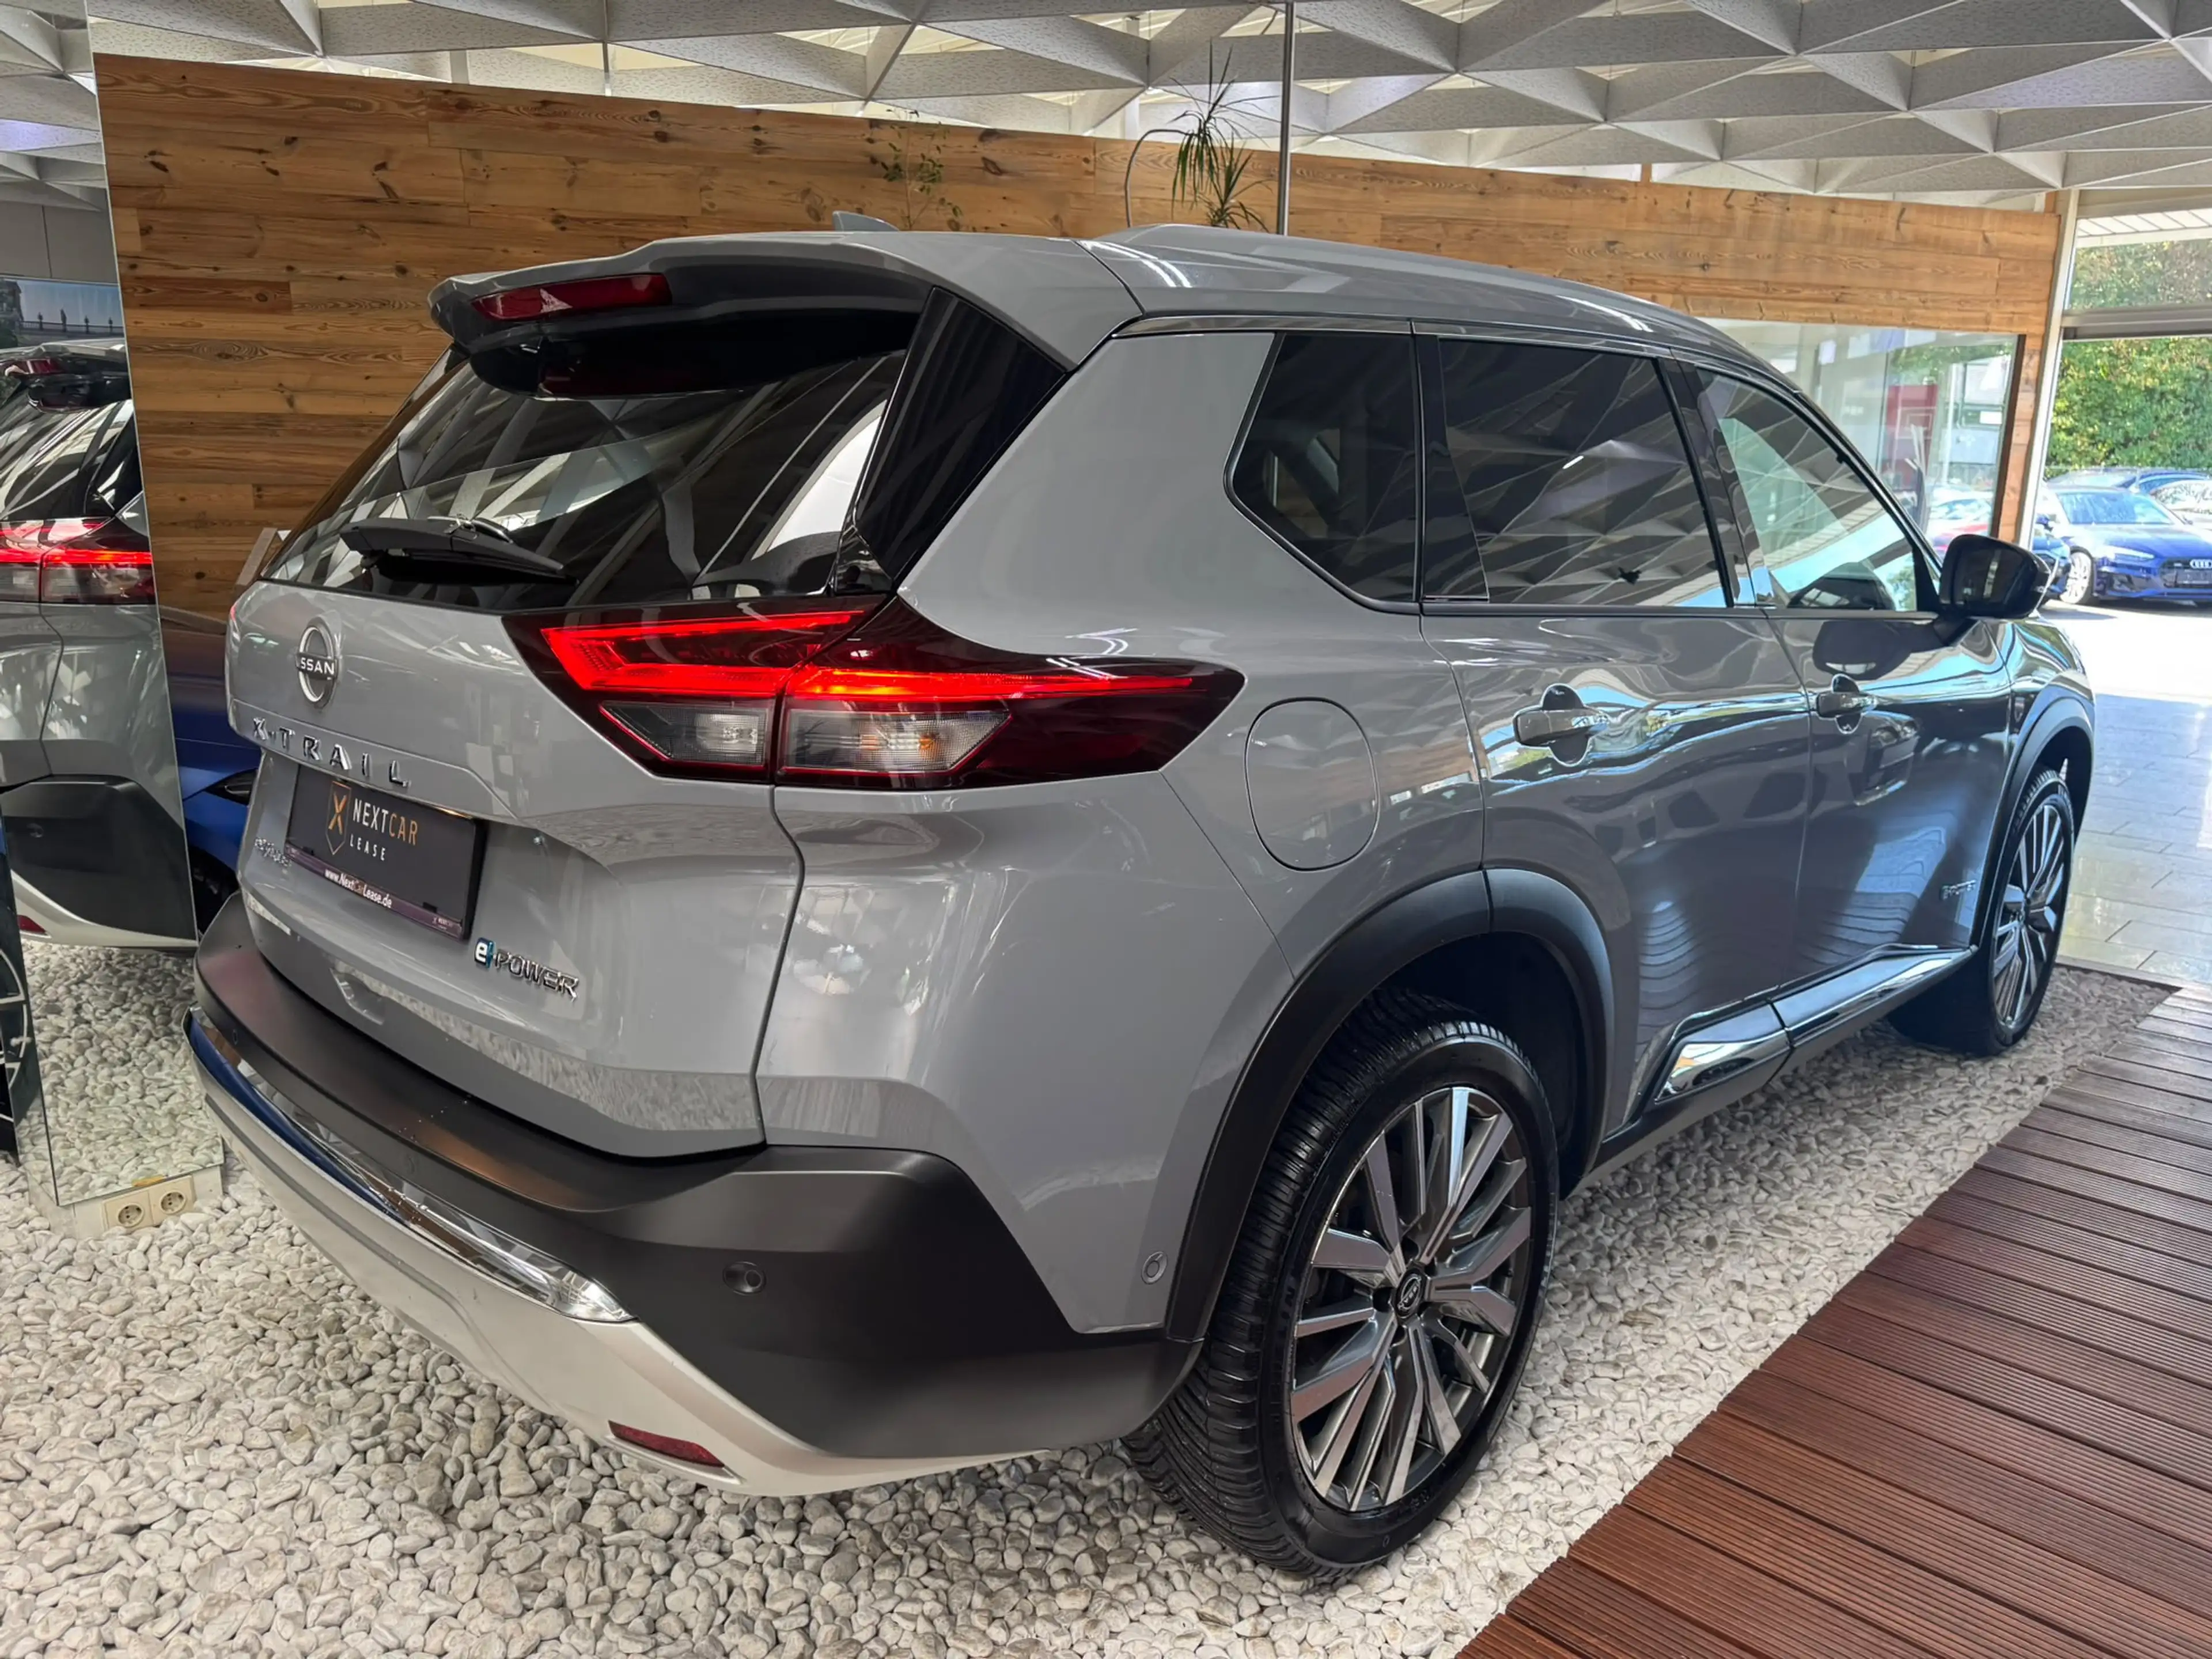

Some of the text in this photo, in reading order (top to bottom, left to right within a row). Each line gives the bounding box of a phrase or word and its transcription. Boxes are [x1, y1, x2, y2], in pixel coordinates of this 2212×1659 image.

[299, 657, 336, 676] SSAN
[253, 717, 411, 787] X-TRAIL
[353, 798, 418, 846] NEXTCAR
[350, 834, 386, 861] LEASE
